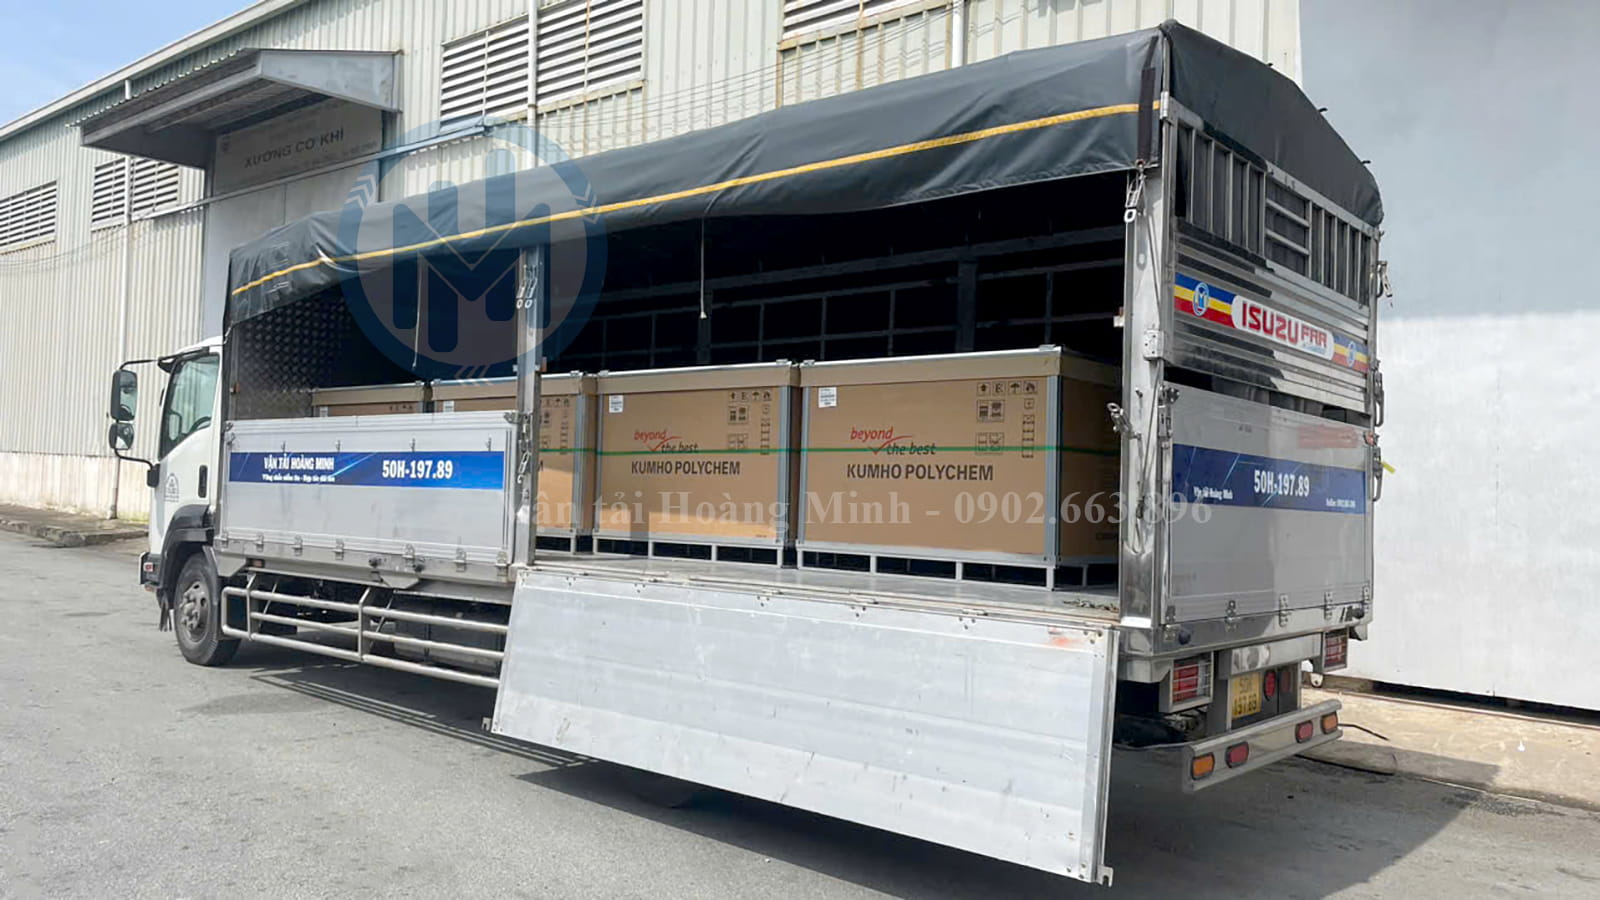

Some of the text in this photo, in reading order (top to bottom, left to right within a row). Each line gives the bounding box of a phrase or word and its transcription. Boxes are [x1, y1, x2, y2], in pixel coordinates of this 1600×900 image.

[1242, 302, 1299, 345] ISUZU
[633, 429, 668, 444] beyond
[850, 427, 893, 443] beyond
[886, 443, 936, 456] the best
[382, 460, 453, 479] 50H-197.89
[631, 461, 741, 475] KUMHO POLYCHEM
[847, 464, 993, 480] KUMHO POLYCHEM
[1254, 469, 1310, 497] 50H-197.89
